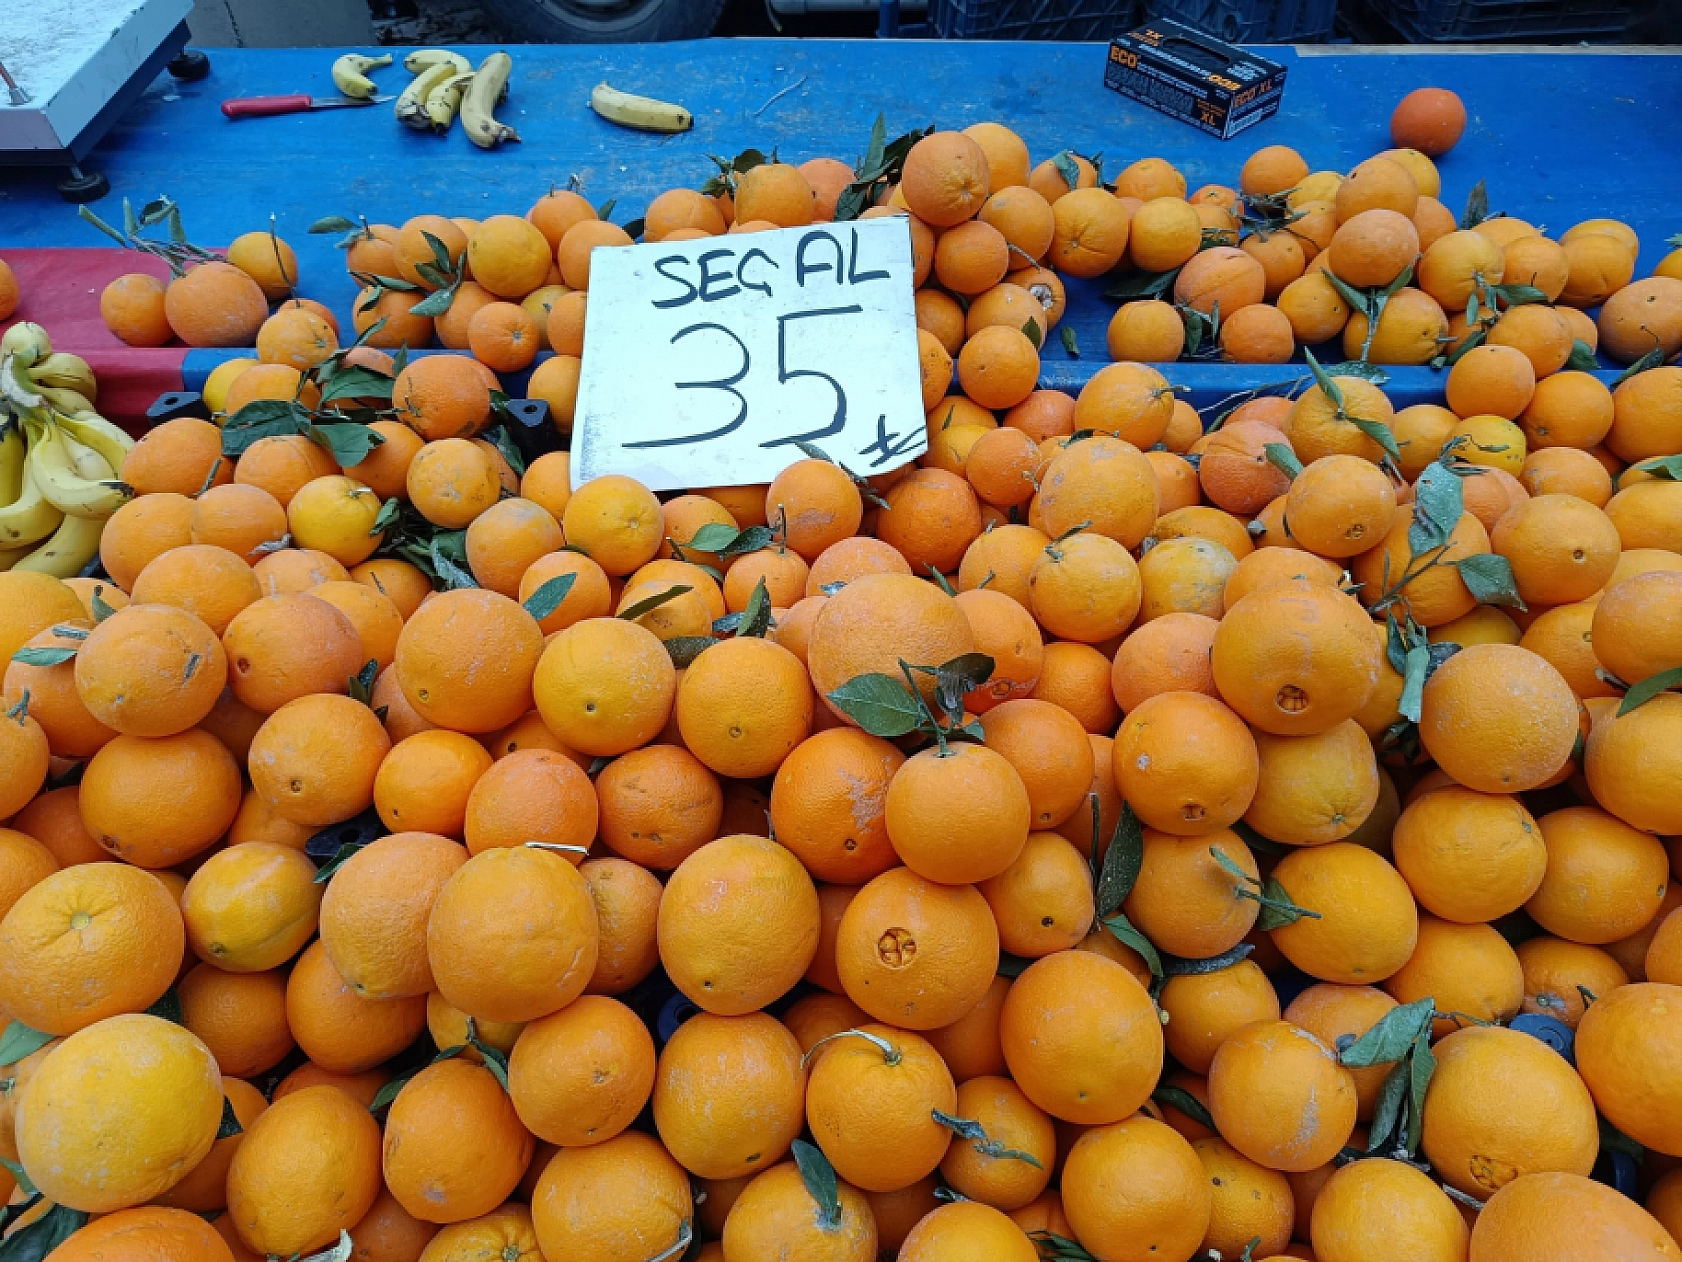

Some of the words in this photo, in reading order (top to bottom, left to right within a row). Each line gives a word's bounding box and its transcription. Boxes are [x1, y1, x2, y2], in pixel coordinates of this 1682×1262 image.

[1111, 46, 1138, 69] ECO
[796, 226, 891, 287] AL
[622, 304, 863, 447] 35
